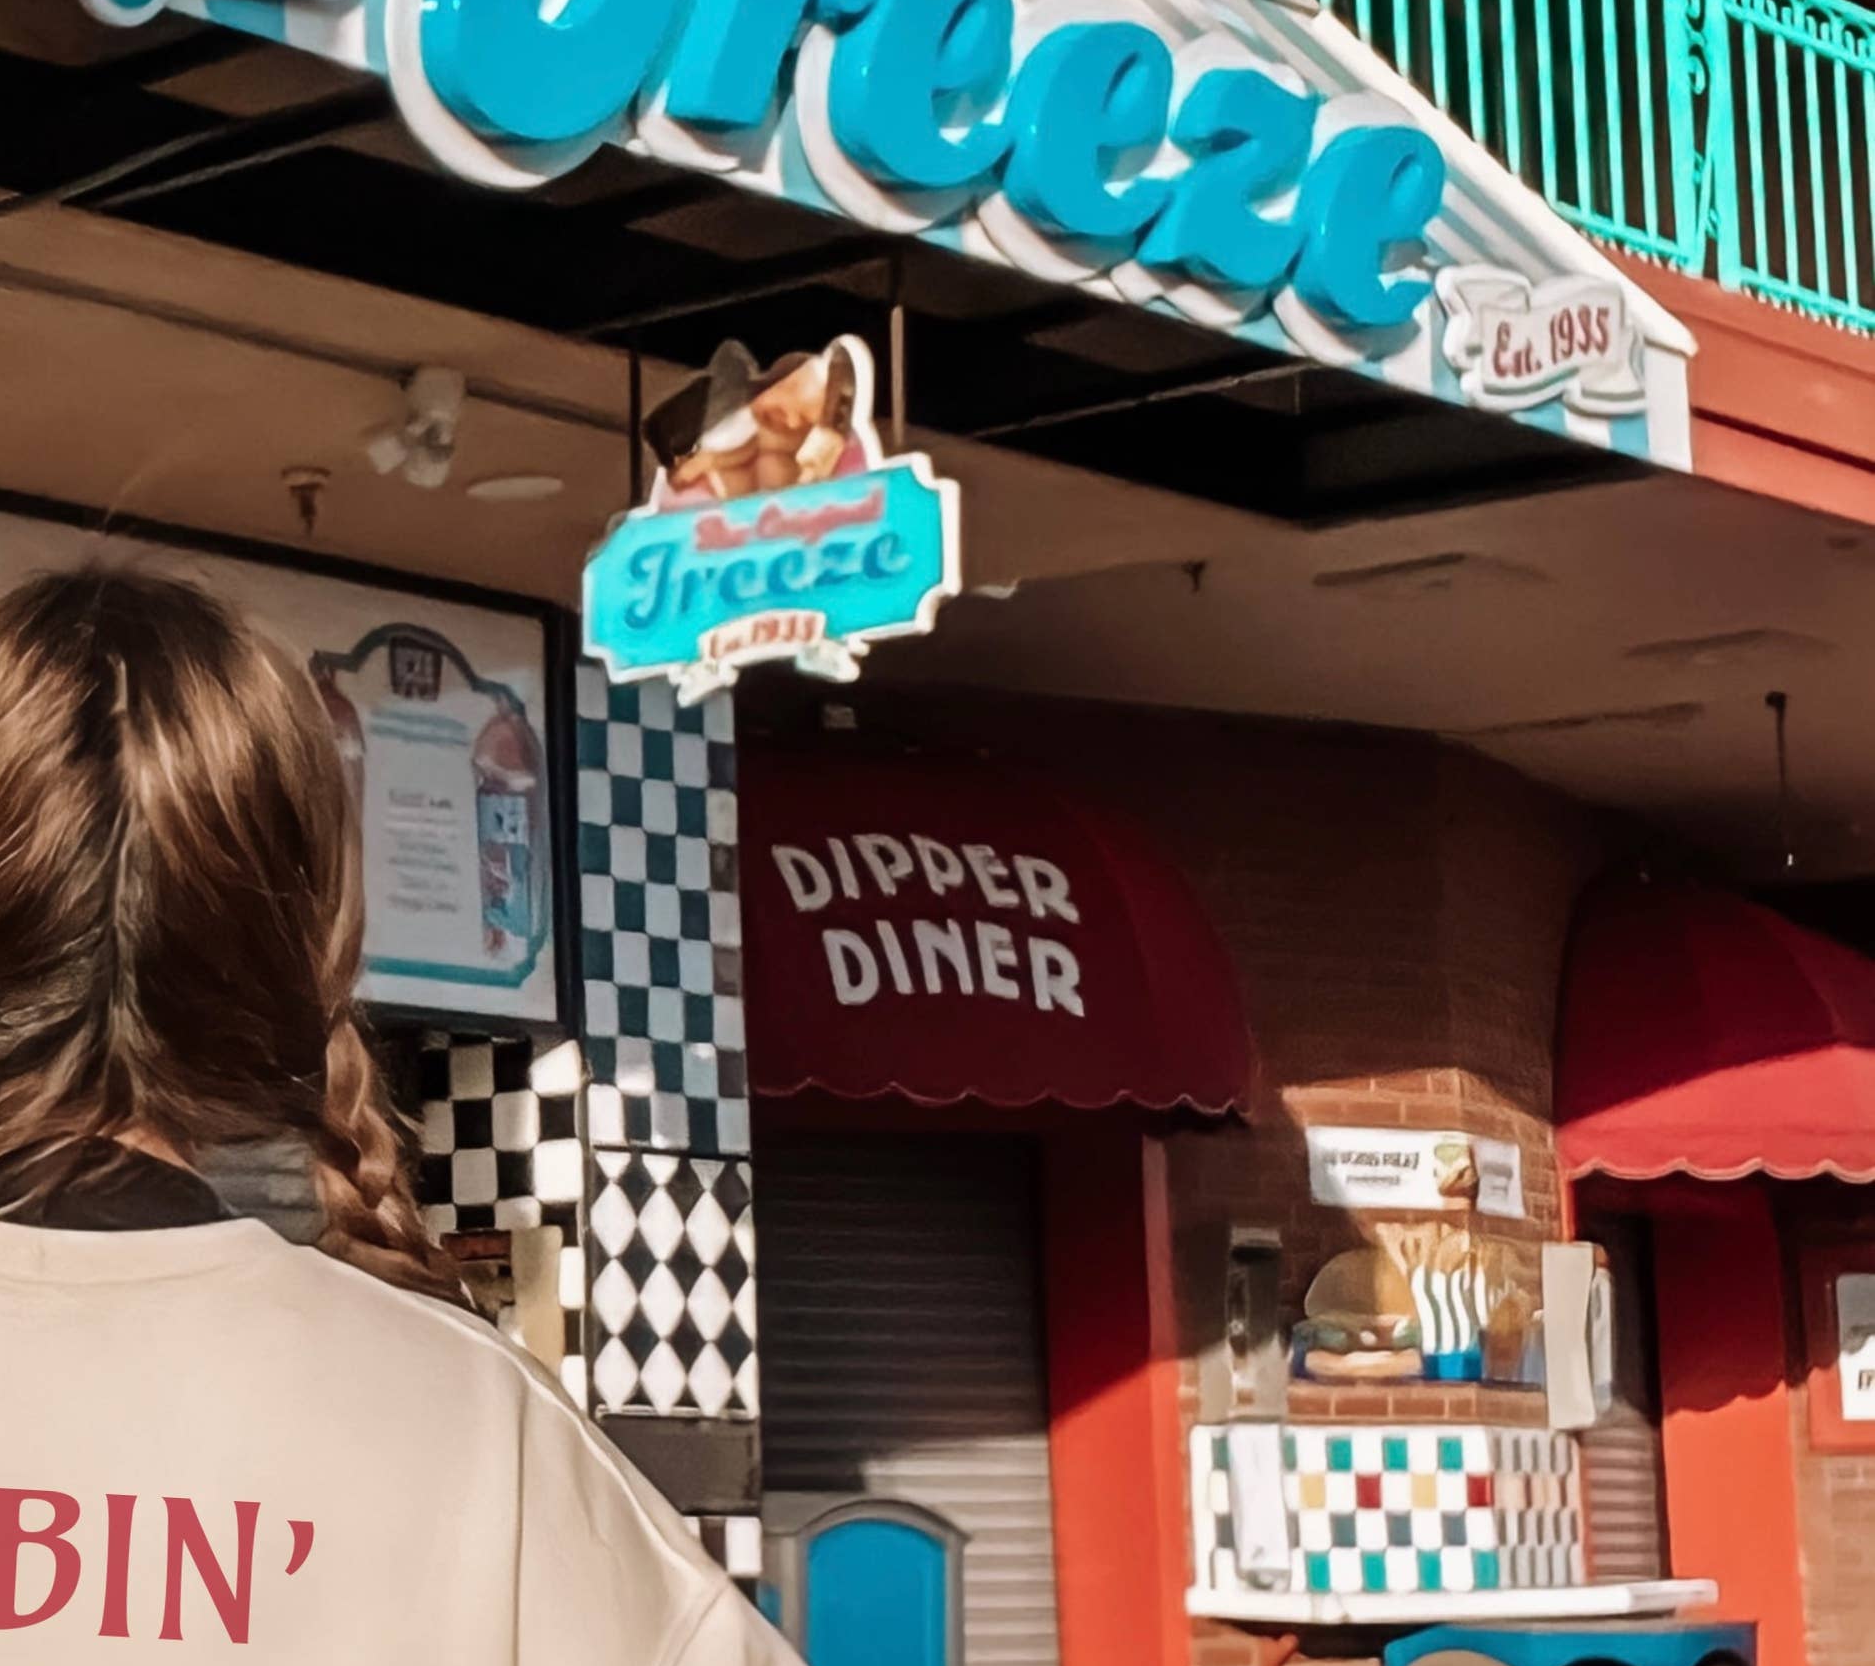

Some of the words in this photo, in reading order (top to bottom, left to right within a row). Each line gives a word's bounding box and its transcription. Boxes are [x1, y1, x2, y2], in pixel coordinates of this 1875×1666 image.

[625, 531, 913, 631] Freeze
[770, 832, 1081, 925] DIPPER
[822, 917, 1085, 1018] DINER
